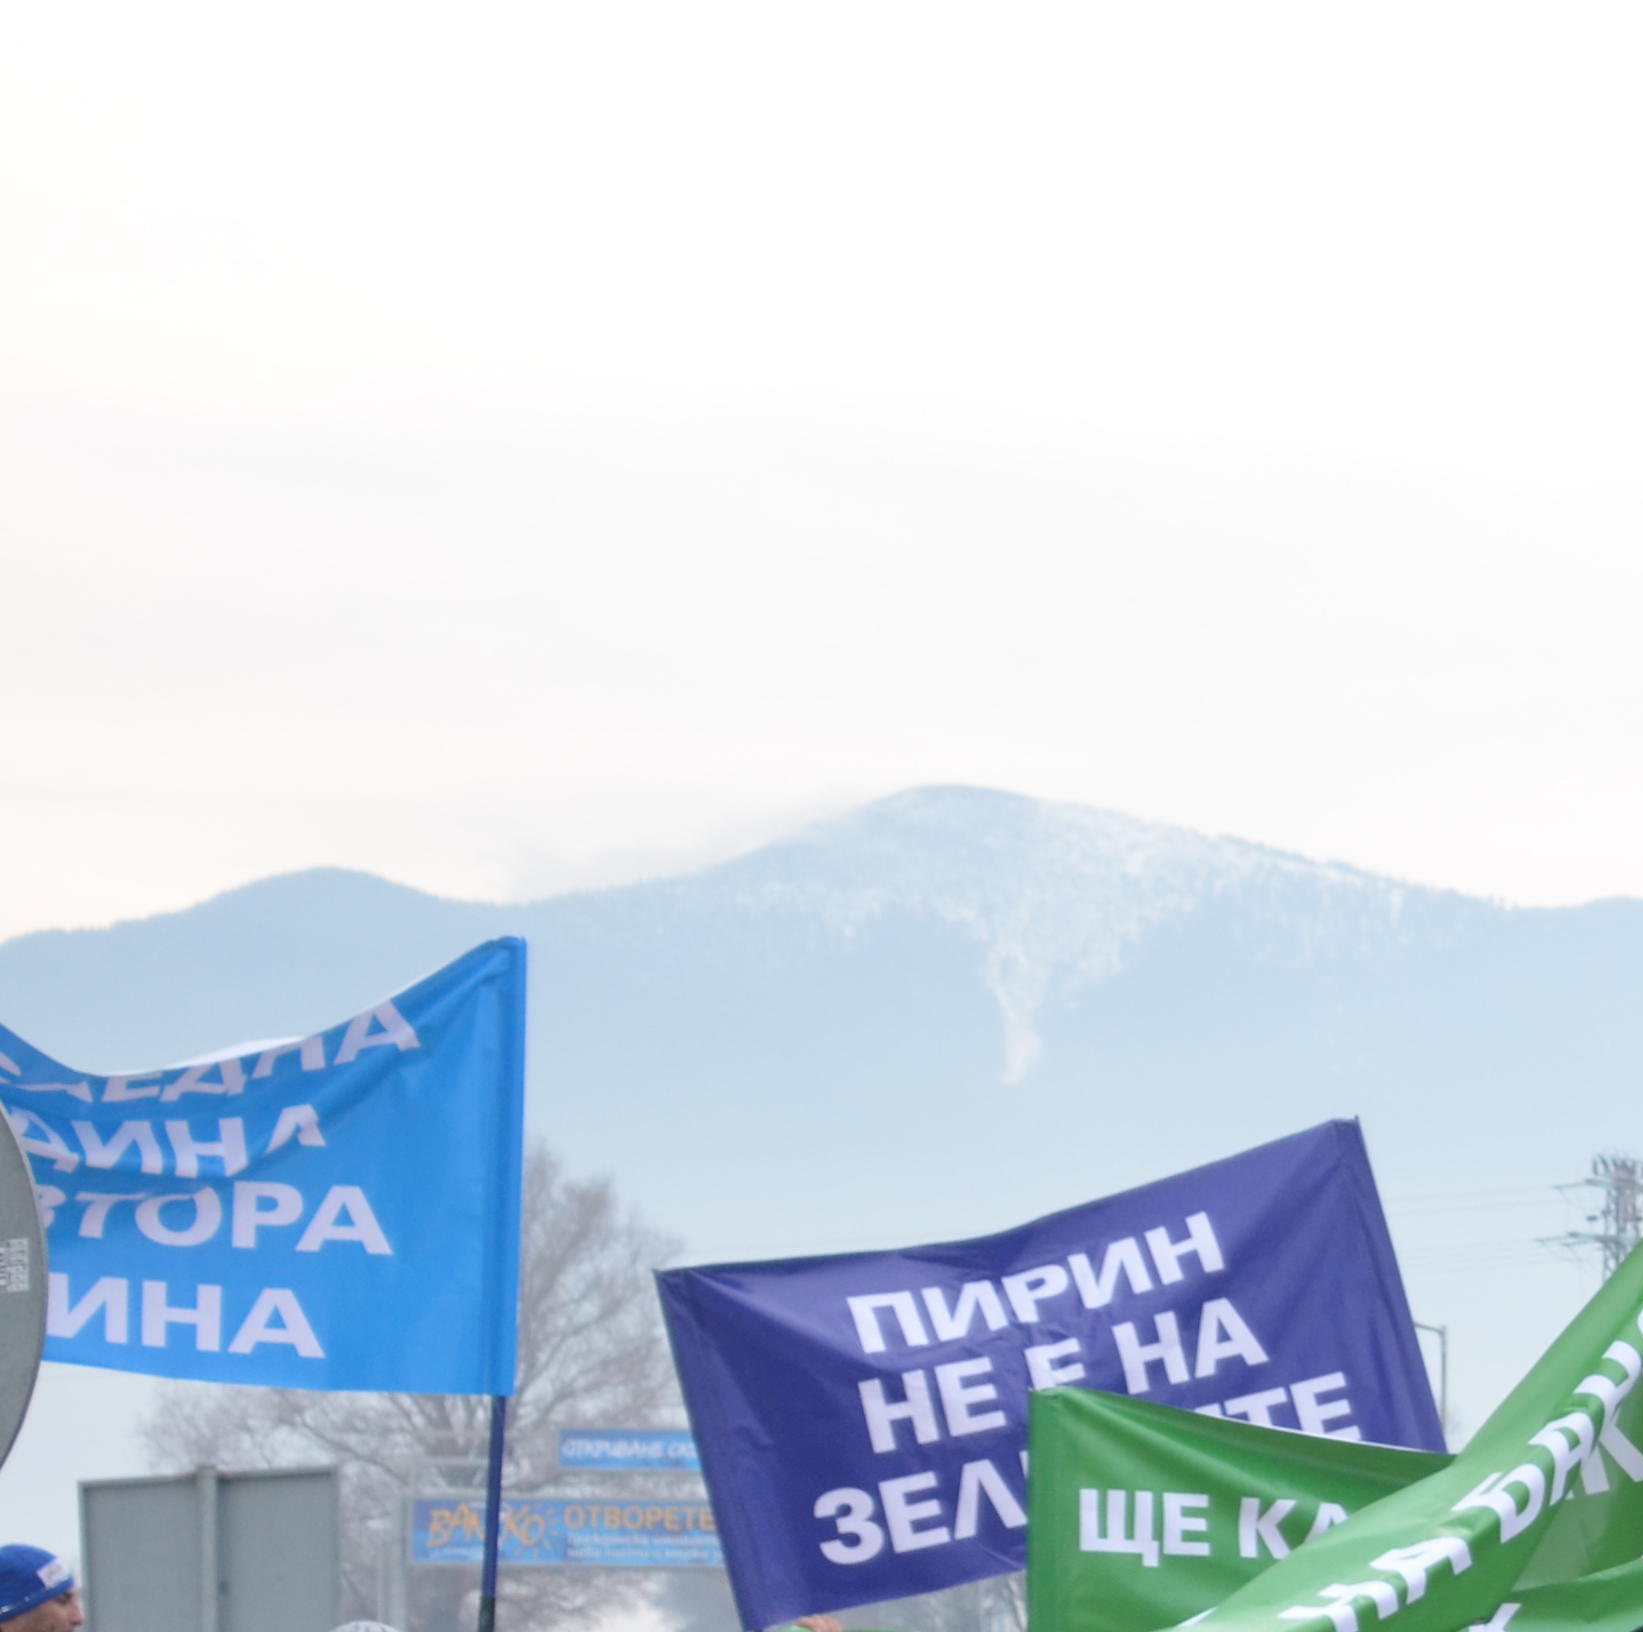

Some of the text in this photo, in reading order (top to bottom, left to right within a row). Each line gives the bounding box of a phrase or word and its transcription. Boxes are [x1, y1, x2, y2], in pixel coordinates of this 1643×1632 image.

[846, 1211, 1225, 1354] ПИРИН
[857, 1356, 1006, 1454] НЕ
[1112, 1298, 1269, 1395] НА
[1079, 1487, 1210, 1567] ЩЕ
